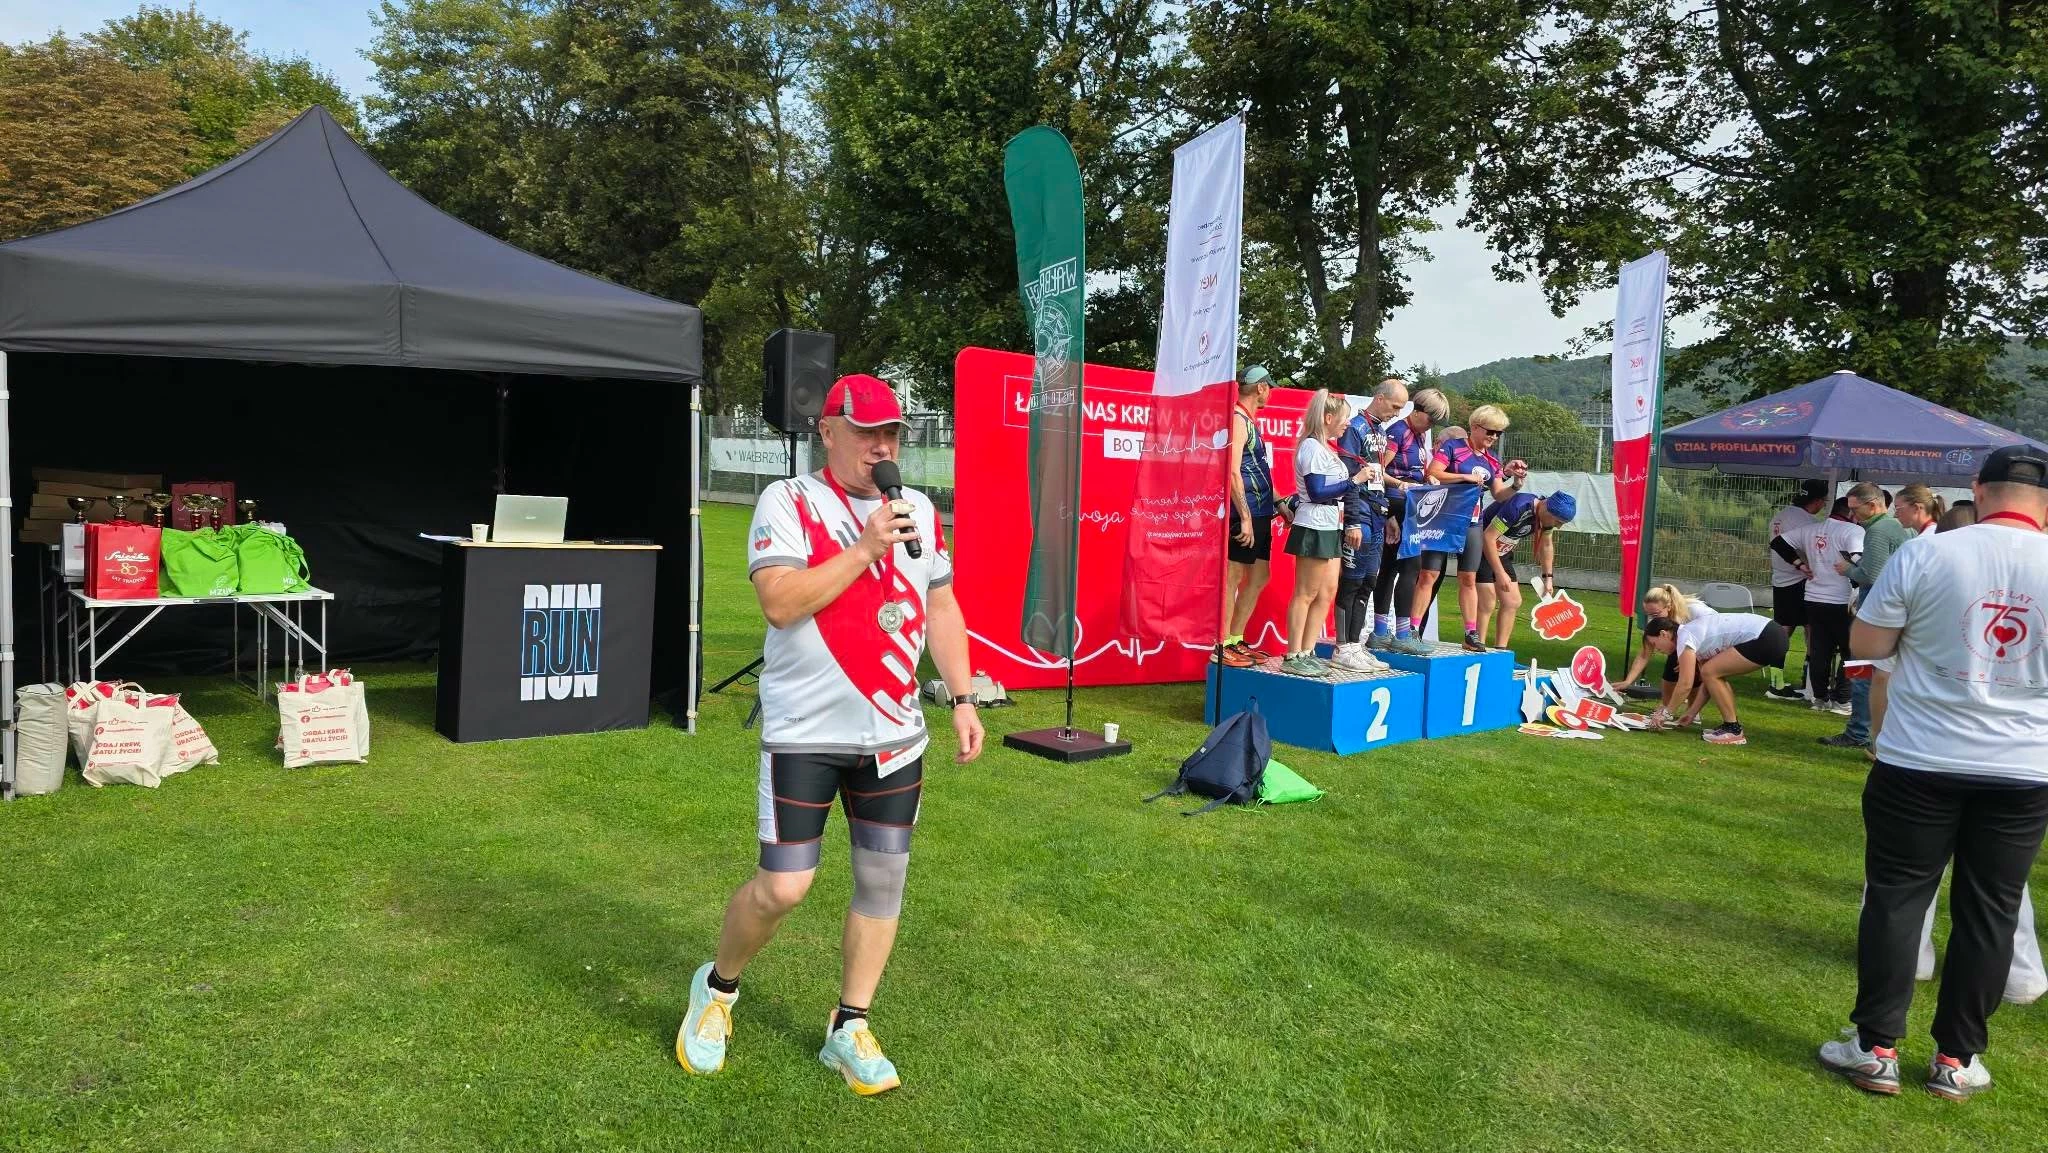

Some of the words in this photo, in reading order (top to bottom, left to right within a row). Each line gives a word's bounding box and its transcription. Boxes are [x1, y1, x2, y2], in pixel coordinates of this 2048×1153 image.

[1082, 400, 1116, 423] NAS
[1113, 436, 1134, 453] BO
[1674, 442, 1708, 452] DZIAŁ
[1710, 442, 1796, 454] PROFILAKTYKI
[1850, 447, 1875, 455] DZIAŁ
[1877, 449, 1942, 458] PROFILAKTYKI
[120, 562, 139, 576] 80
[521, 608, 601, 676] RUN
[1462, 662, 1482, 727] 1
[1366, 686, 1391, 743] 2
